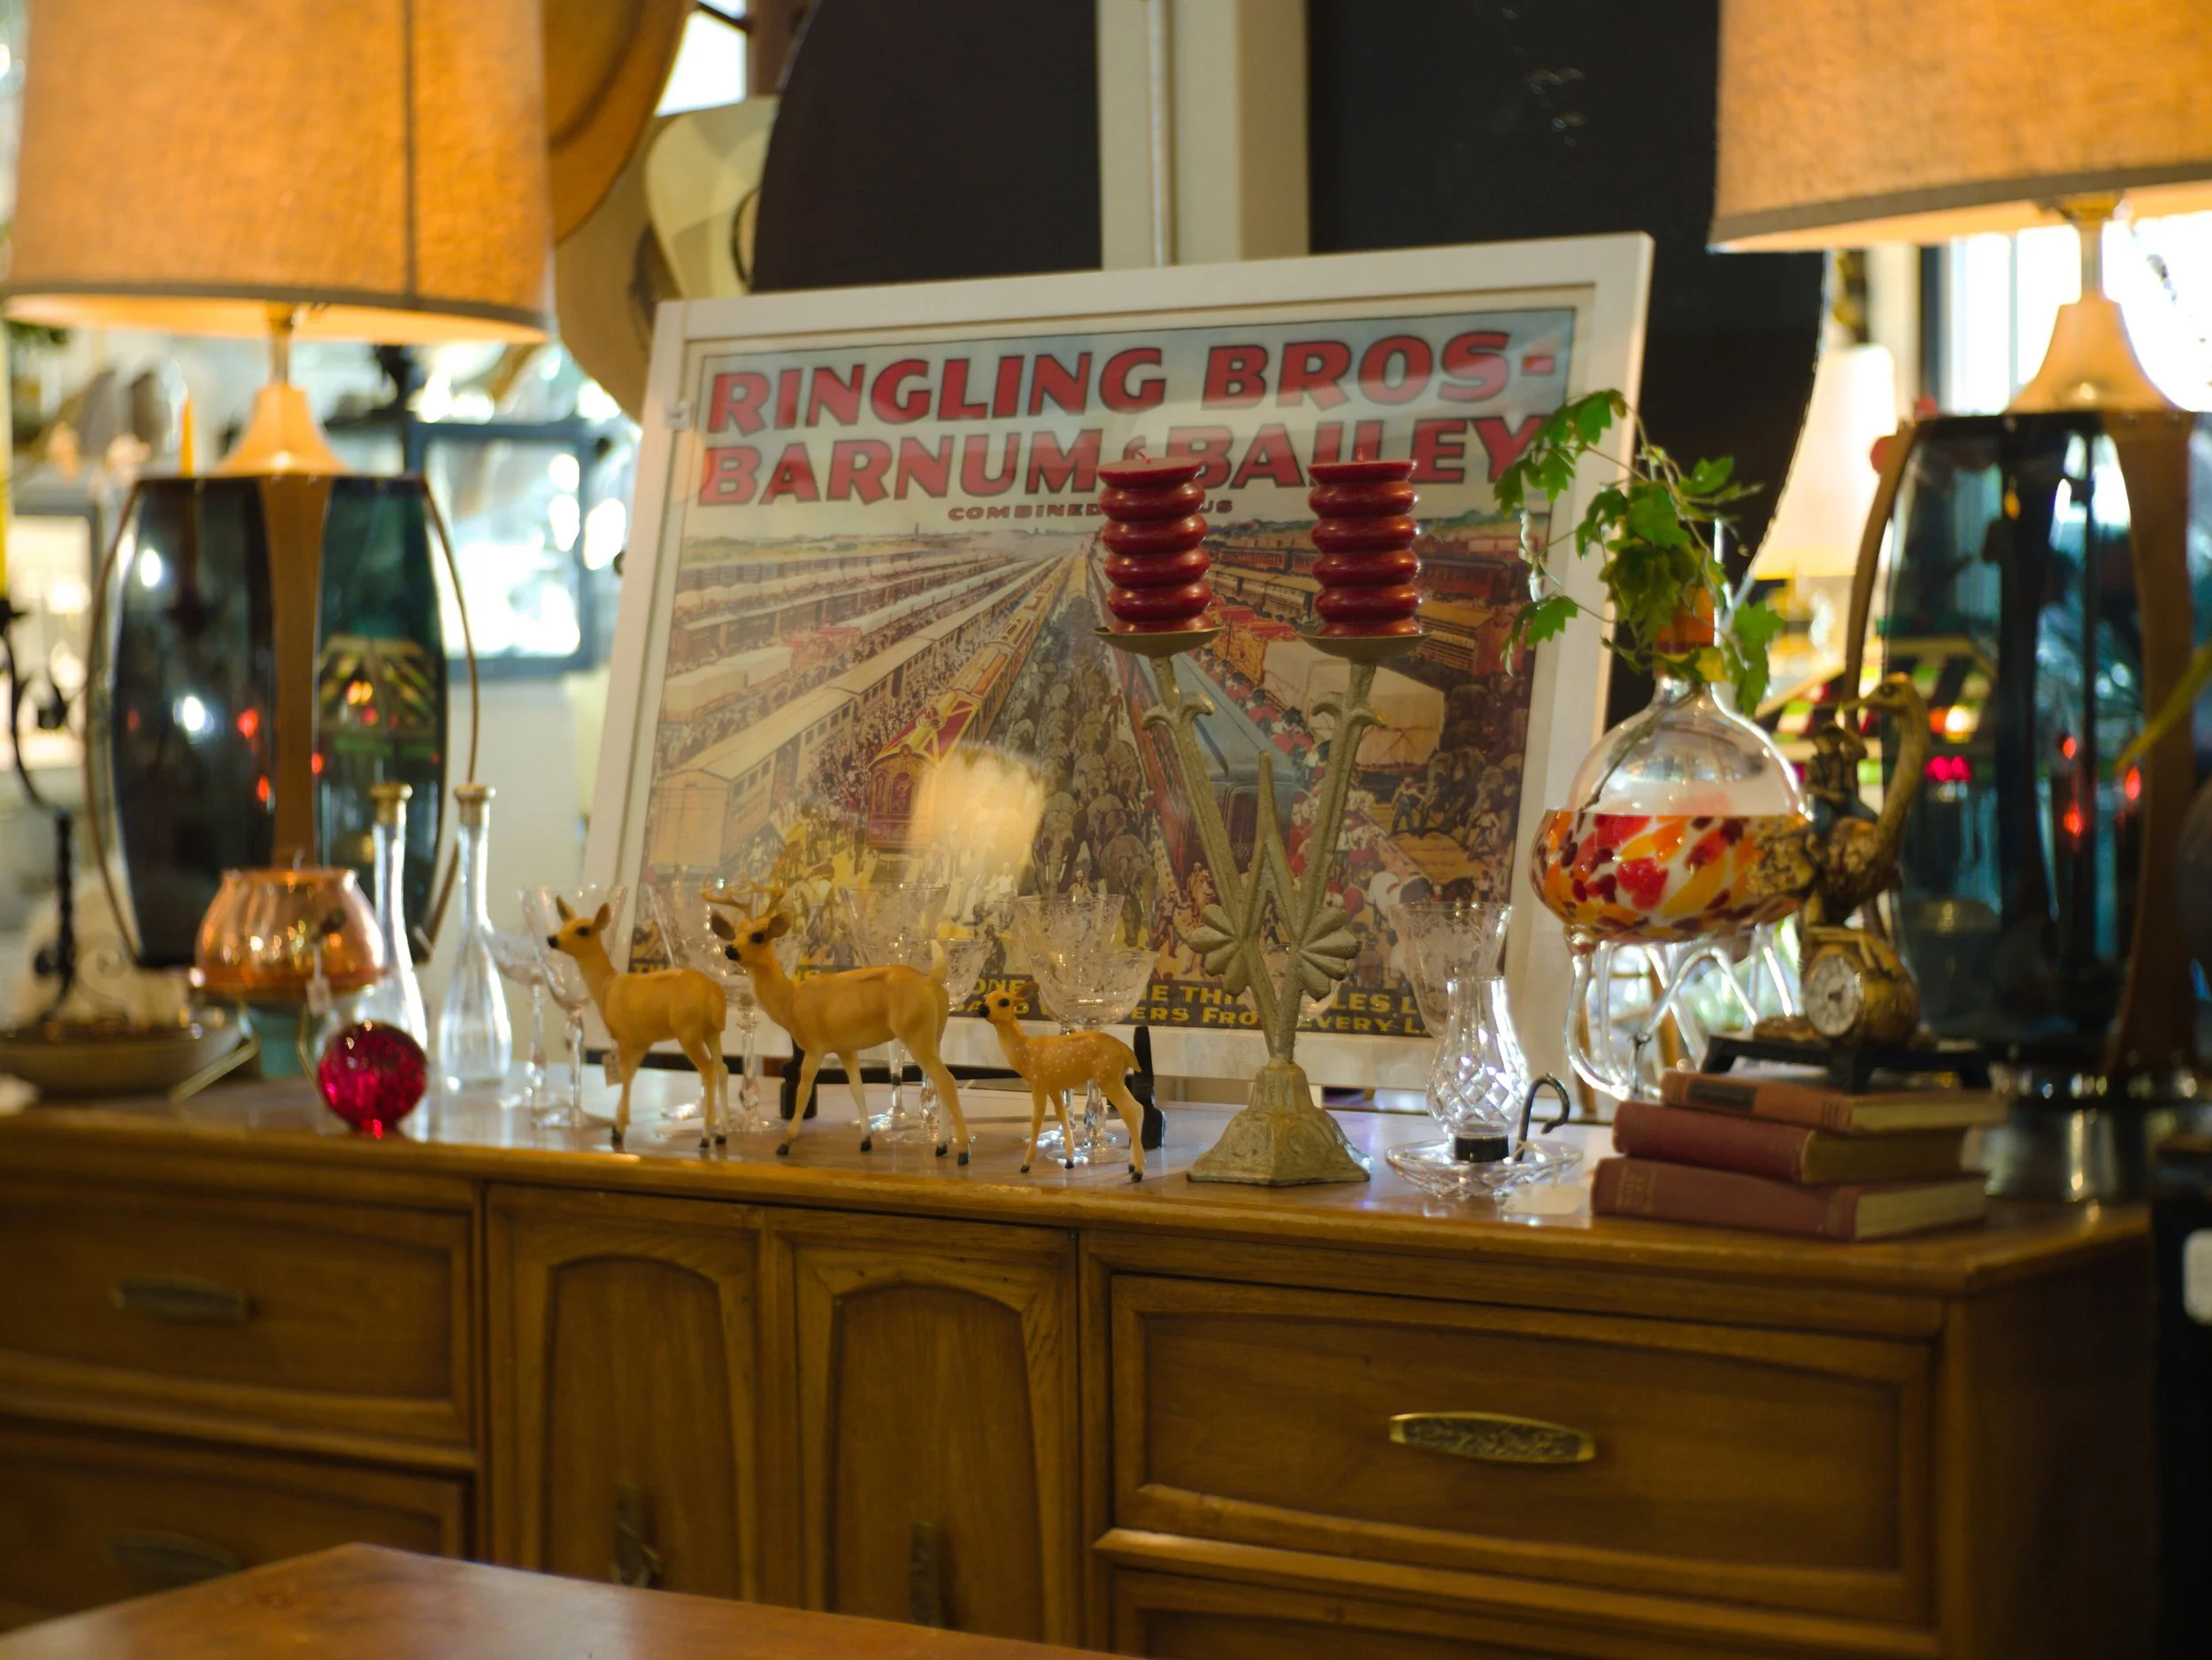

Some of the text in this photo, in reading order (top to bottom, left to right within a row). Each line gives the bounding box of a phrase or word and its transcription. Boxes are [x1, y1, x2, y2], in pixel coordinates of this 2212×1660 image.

[707, 346, 1167, 436] RINGLING
[697, 428, 1103, 506] BARNUM
[947, 502, 1102, 522] COMBINED
[1202, 1006, 1259, 1026] FRO
